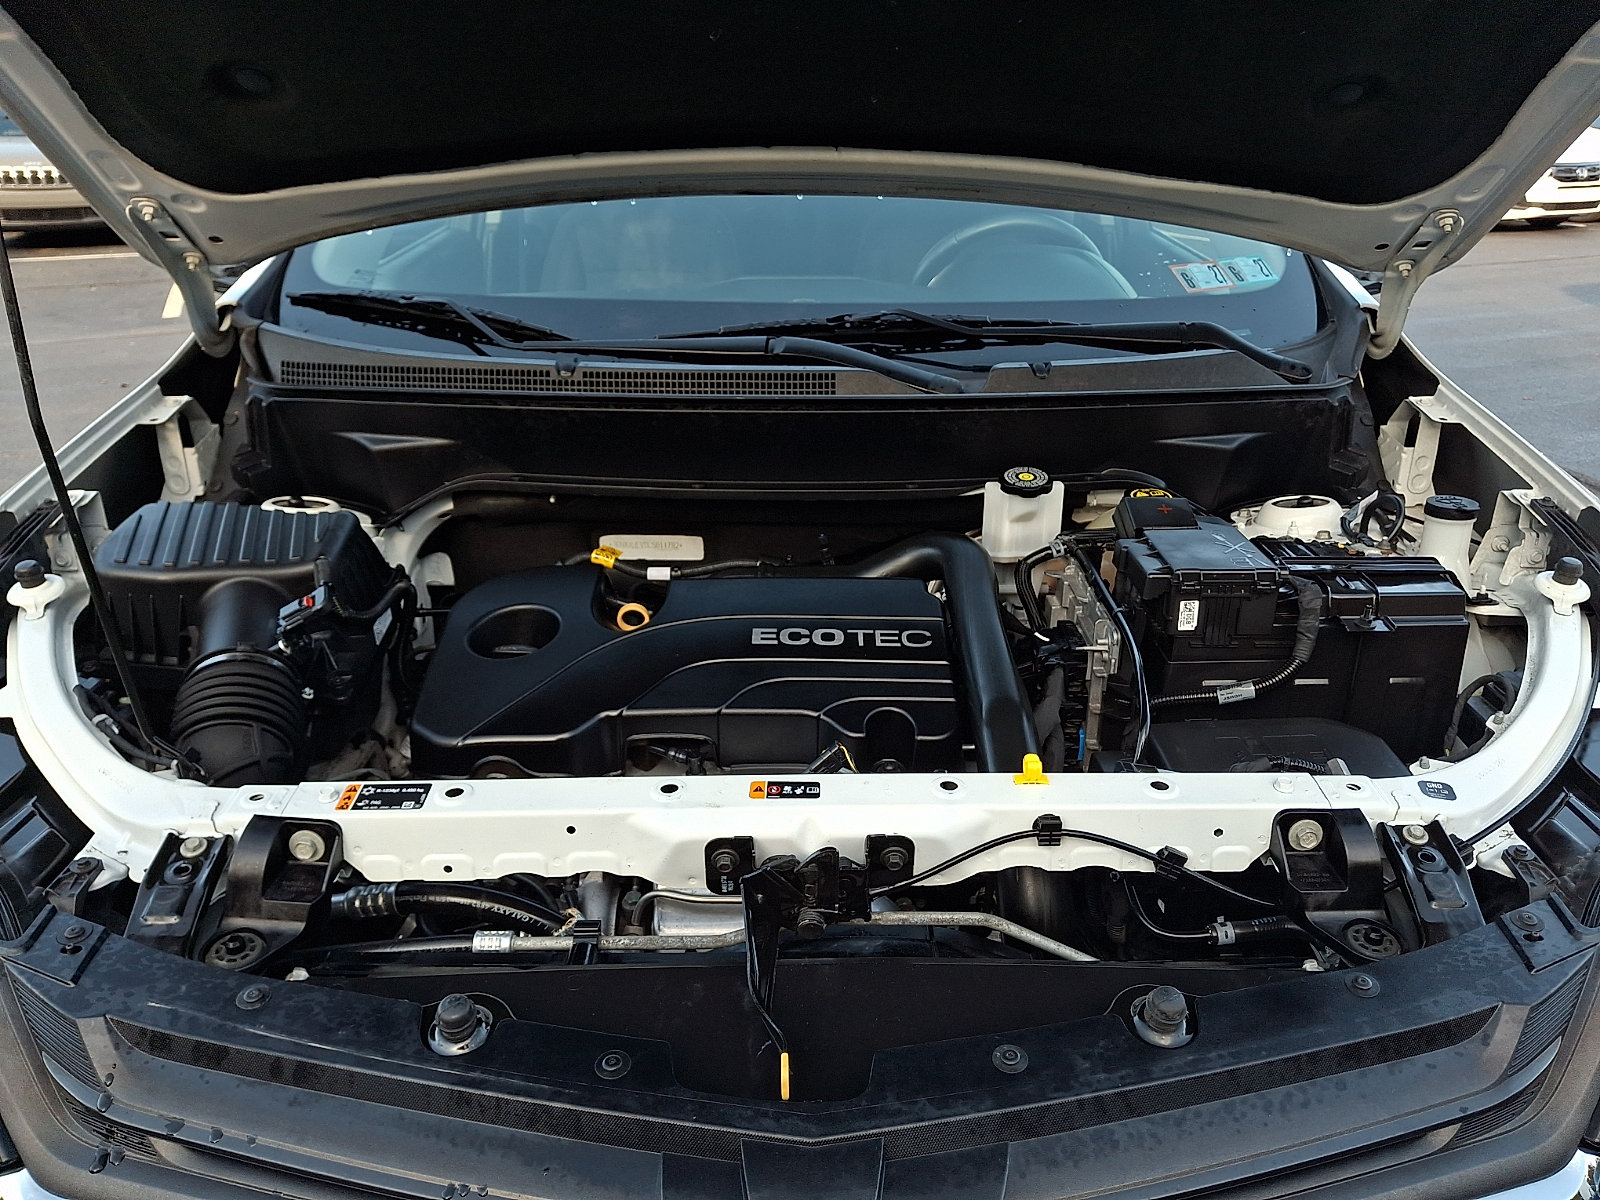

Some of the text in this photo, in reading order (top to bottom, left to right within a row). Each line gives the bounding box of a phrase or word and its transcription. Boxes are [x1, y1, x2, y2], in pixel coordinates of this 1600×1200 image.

[1180, 264, 1228, 289] 6 27
[1227, 258, 1273, 282] 6 27
[751, 627, 933, 648] ECOTEC
[491, 904, 530, 922] GALAXY
